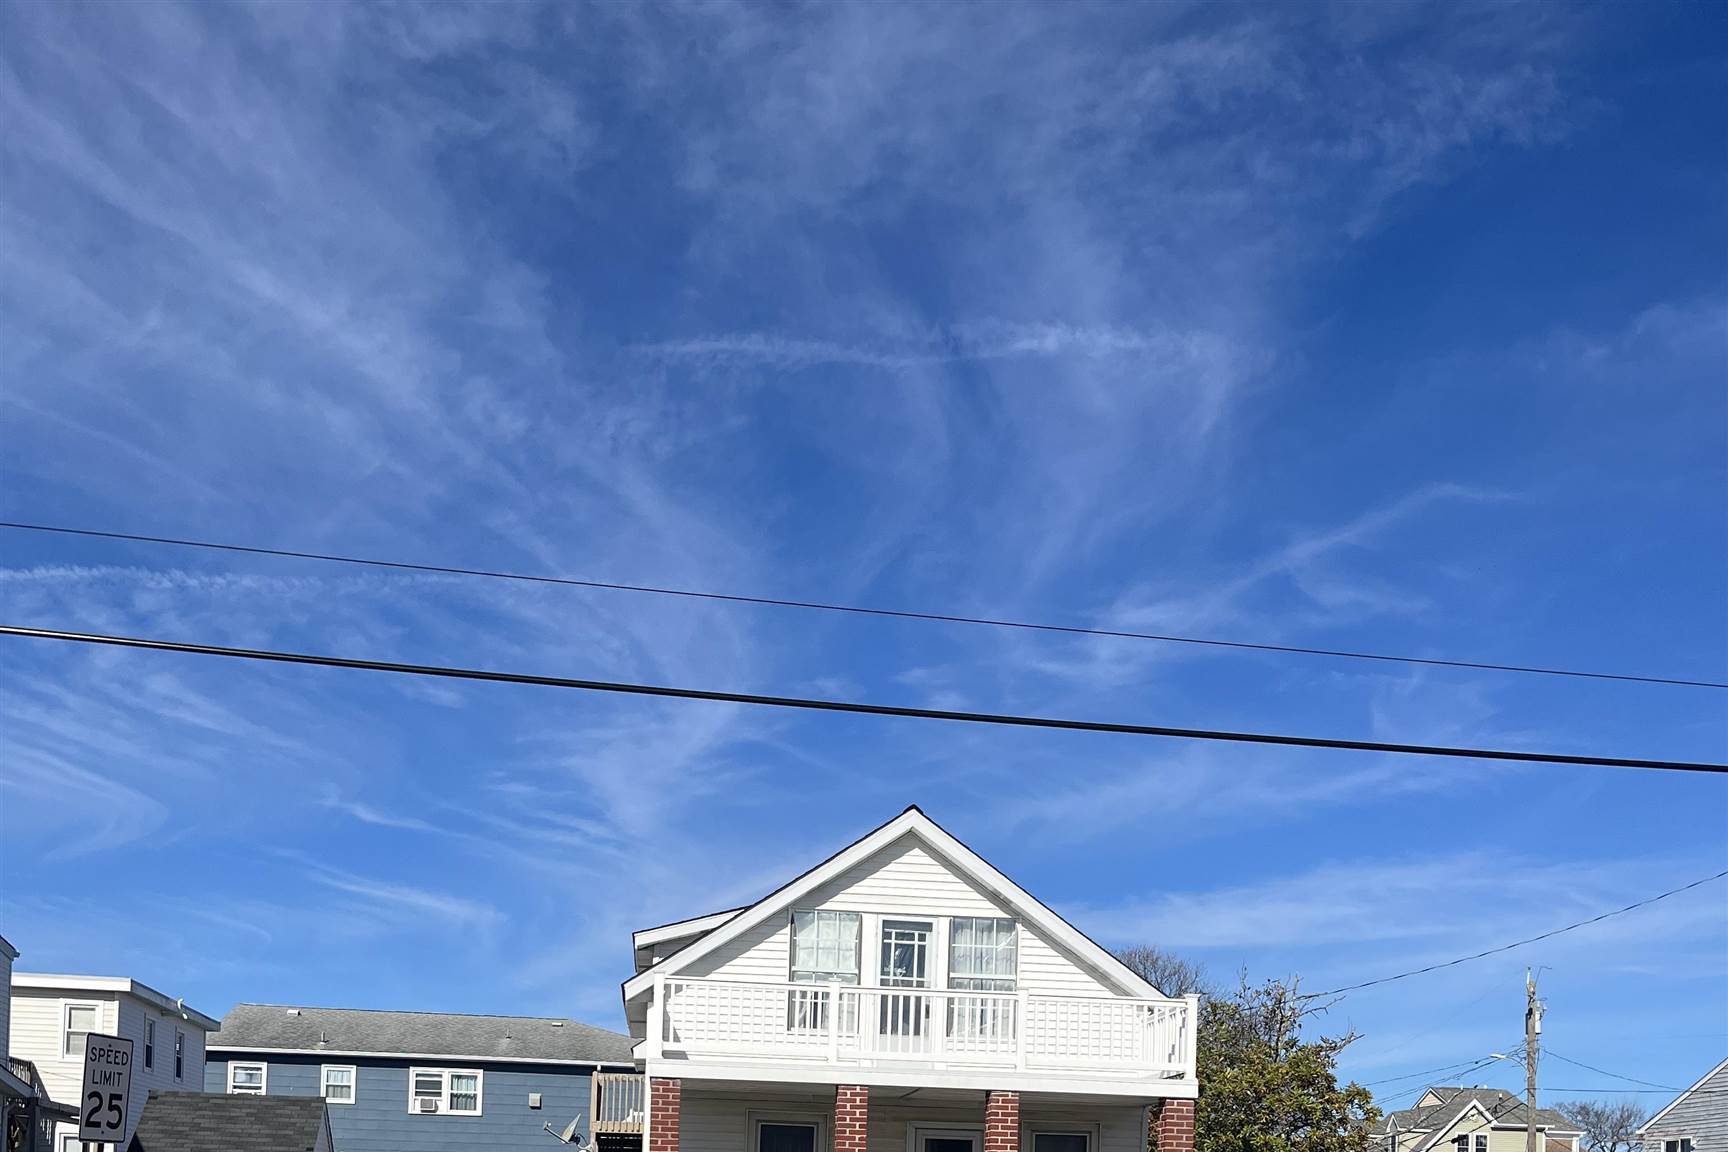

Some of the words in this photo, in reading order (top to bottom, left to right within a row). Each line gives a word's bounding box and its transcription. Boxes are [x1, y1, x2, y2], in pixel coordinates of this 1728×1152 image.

[89, 1046, 129, 1066] SPEED
[92, 1069, 123, 1087] LIMIT
[84, 1091, 123, 1130] 25
